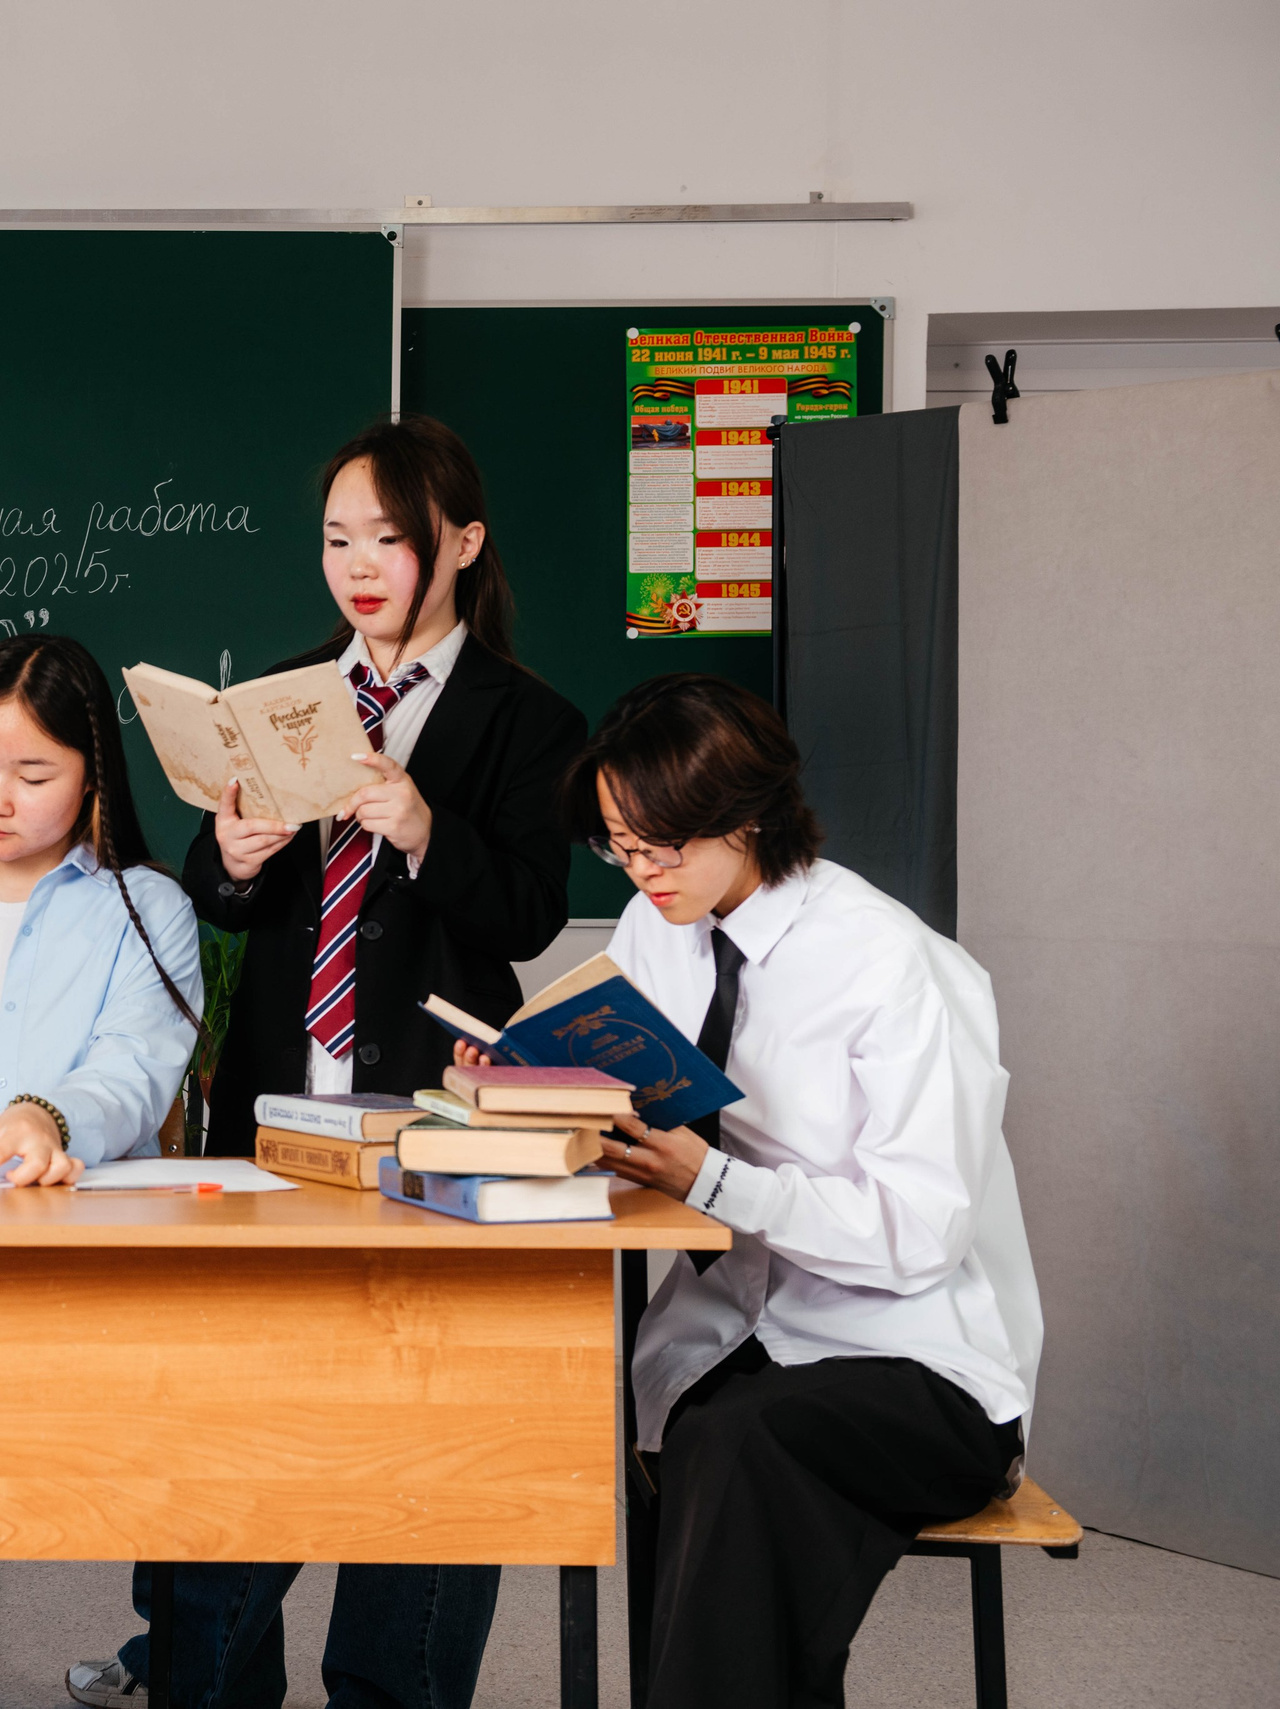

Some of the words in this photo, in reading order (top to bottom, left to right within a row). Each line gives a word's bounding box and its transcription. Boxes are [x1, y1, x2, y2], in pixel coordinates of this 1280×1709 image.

[694, 330, 805, 345] Отечественная
[808, 327, 855, 343] Война
[631, 349, 650, 362] 22
[654, 351, 693, 362] июня
[698, 348, 727, 361] 1941
[731, 352, 742, 361] г.
[758, 346, 768, 360] 9
[772, 349, 799, 360] мая
[804, 345, 837, 359] 1945
[840, 349, 851, 358] г.
[655, 365, 697, 375] ВЕЛИКИЙ
[699, 366, 735, 374] ПОДВИГ
[738, 365, 785, 373] ВЕЛИКОГО
[787, 364, 828, 373] НАРОДА
[723, 380, 759, 394] 1941
[634, 404, 660, 414] Общая
[661, 404, 688, 413] победа
[721, 430, 761, 445] 1942
[721, 482, 761, 496] 1943
[75, 478, 261, 577] работа
[721, 533, 761, 547] 1944
[721, 583, 761, 598] 1945
[269, 701, 321, 731] Русский
